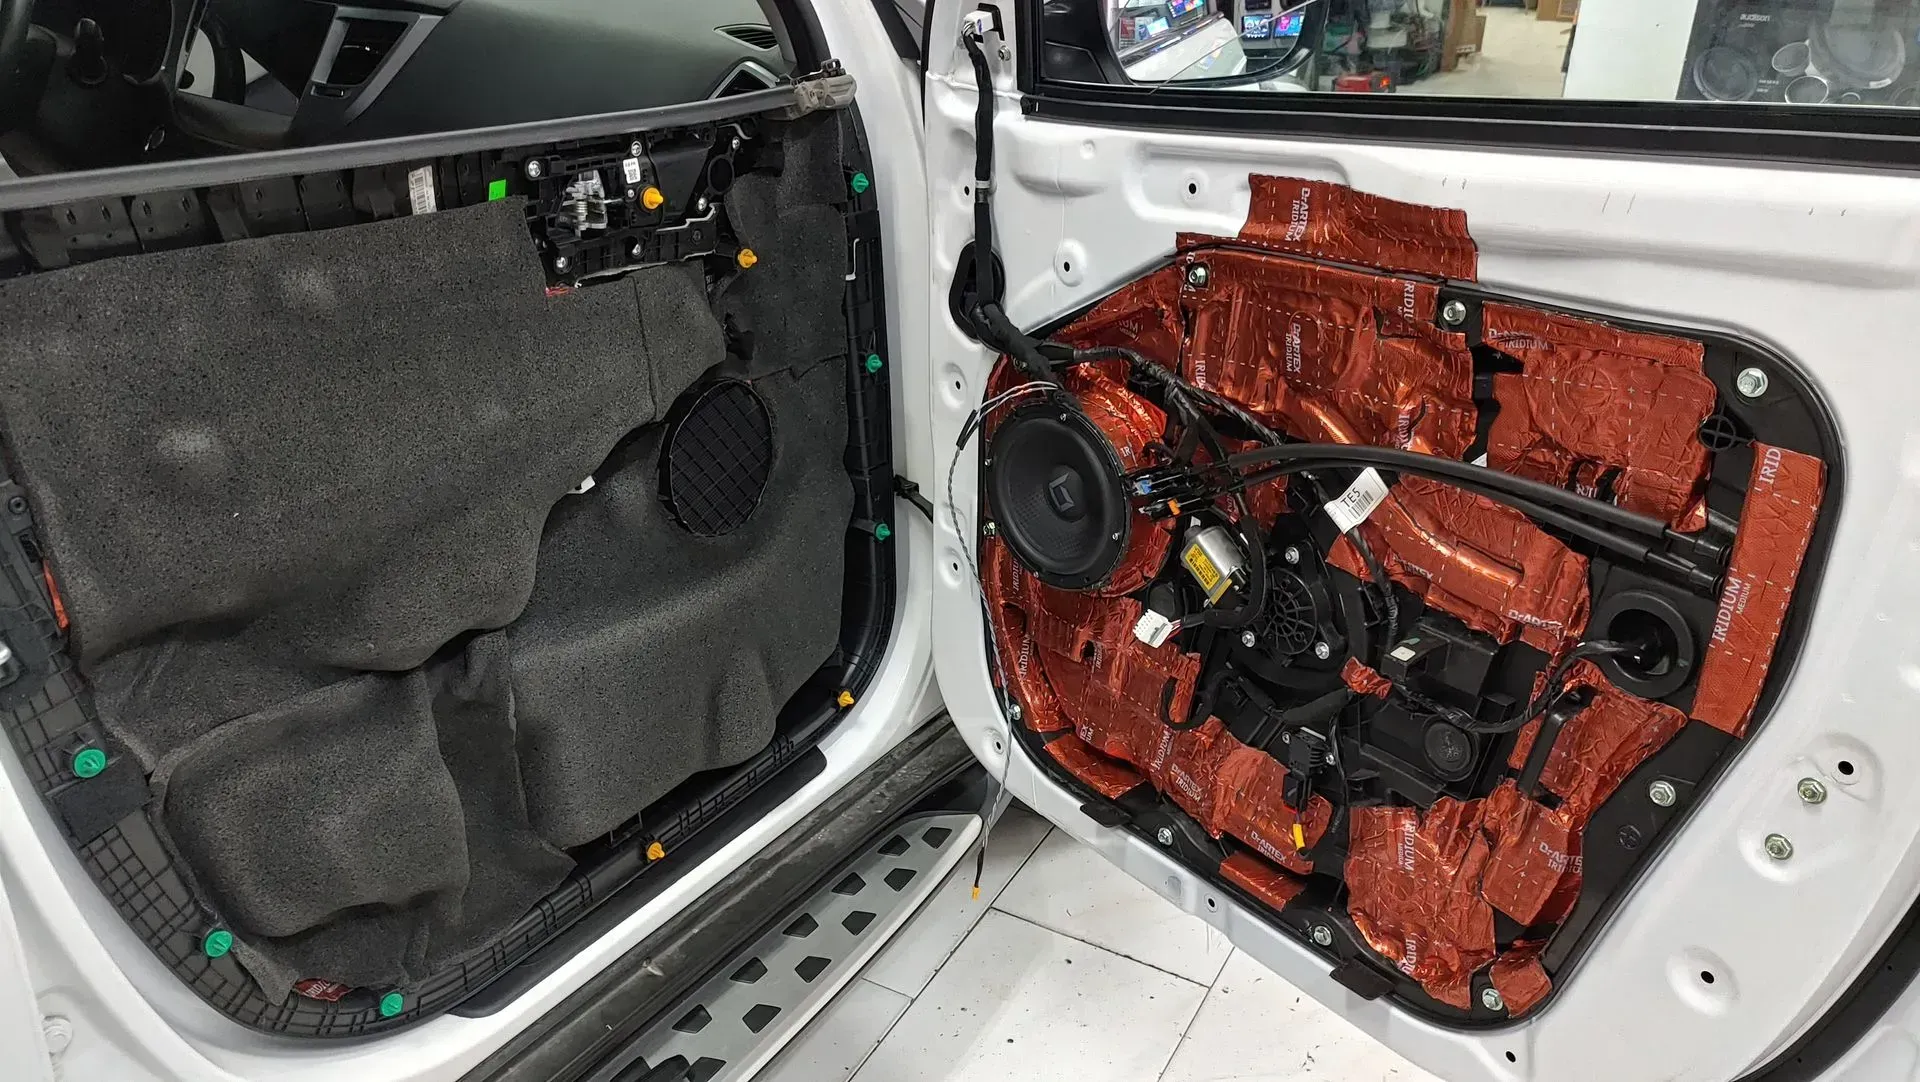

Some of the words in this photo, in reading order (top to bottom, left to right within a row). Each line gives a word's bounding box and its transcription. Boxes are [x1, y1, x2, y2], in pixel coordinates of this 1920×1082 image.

[1285, 200, 1300, 241] IRIDIUM
[1285, 333, 1293, 371] IRIDIUM
[1759, 448, 1781, 484] IRID
[1712, 576, 1742, 642] IRIDIUM
[1736, 582, 1751, 614] MEDIUM
[1176, 777, 1201, 802] IRIDIUM
[1403, 820, 1416, 871] IRIDIUM
